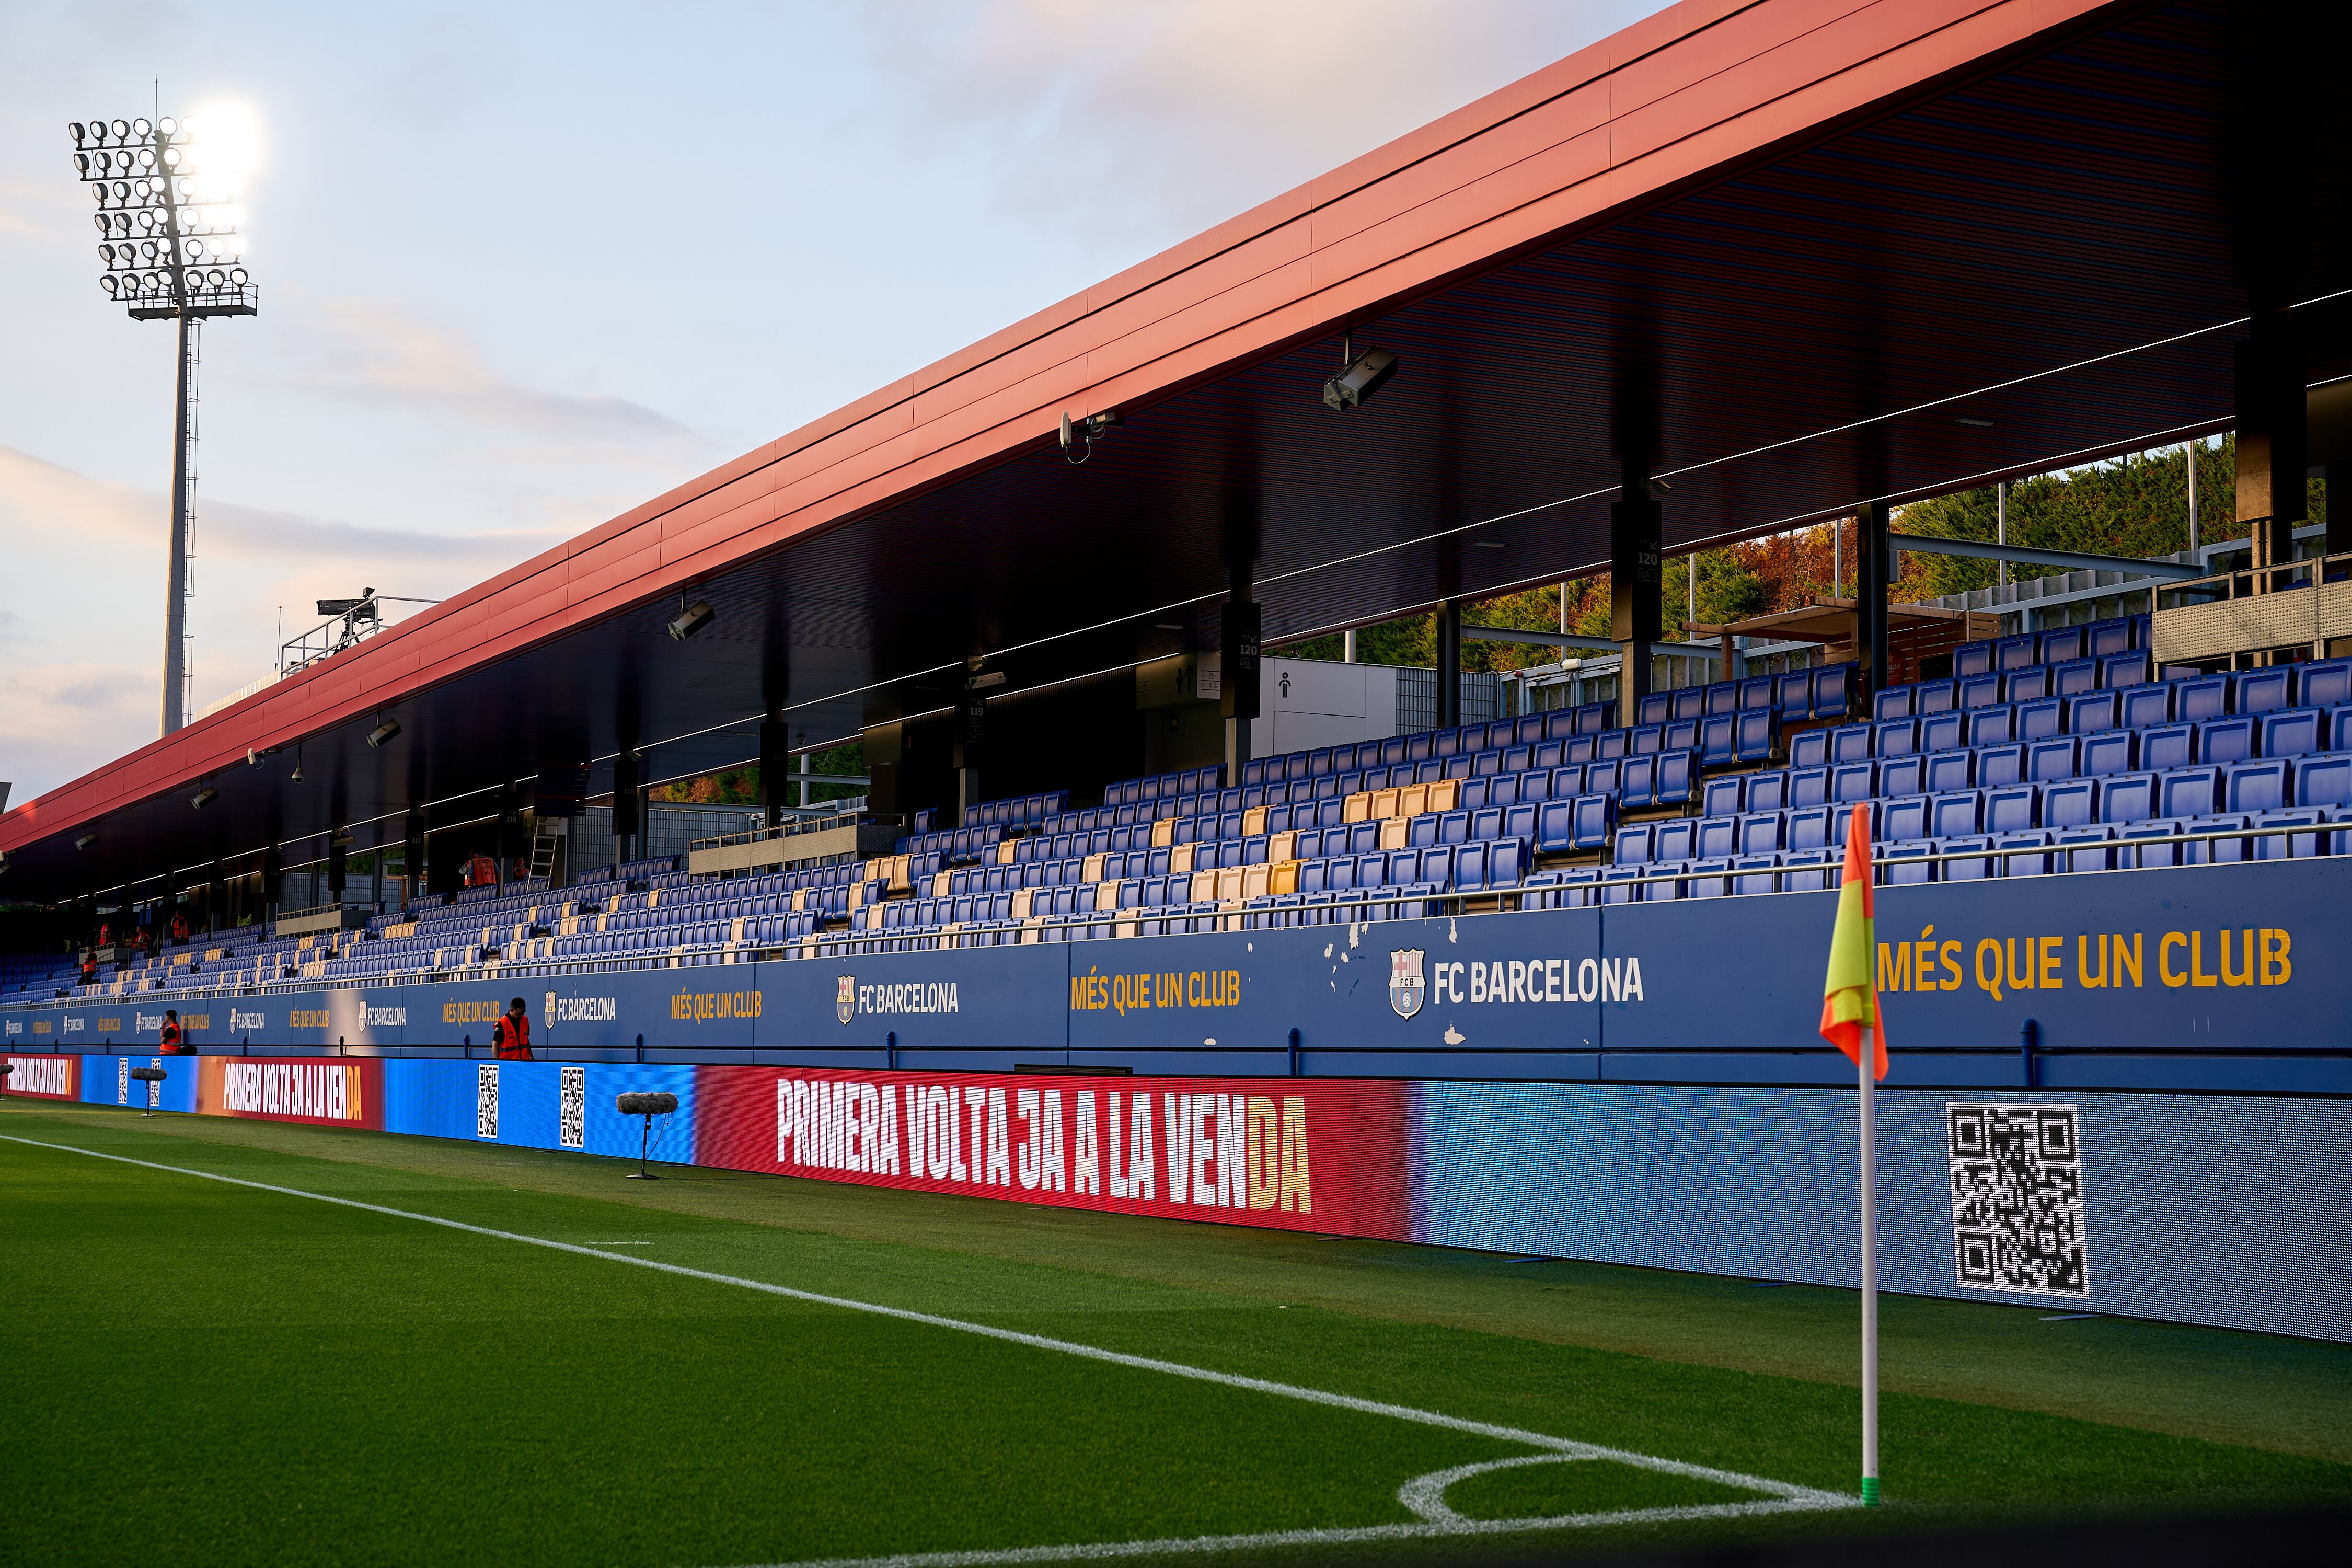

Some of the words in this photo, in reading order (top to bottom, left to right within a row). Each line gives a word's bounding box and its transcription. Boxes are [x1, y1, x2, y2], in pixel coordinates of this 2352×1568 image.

[1638, 552, 1658, 566] 120
[1240, 644, 1258, 655] 120
[970, 707, 984, 716] 119
[1878, 924, 1963, 992] MÉS
[1976, 936, 2063, 1001] QUE
[2078, 933, 2143, 988] UN
[2159, 928, 2292, 987] CLUB
[1071, 965, 1108, 1009] MÉS
[1113, 974, 1150, 1016] QUE
[1156, 972, 1182, 1007] UN
[1189, 970, 1240, 1007] CLUB
[1400, 978, 1414, 987] FCB
[1434, 962, 1465, 1004] FC
[1471, 957, 1644, 1003] BARCELONA
[558, 998, 567, 1021] FC
[568, 997, 616, 1021] BARCELONA
[672, 986, 693, 1019] MÉS
[694, 992, 715, 1024] QUE
[717, 991, 732, 1018] UN
[734, 990, 762, 1018] CLUB
[859, 985, 874, 1013] FC
[877, 982, 958, 1013] BARCELONA
[141, 1017, 145, 1030] FC
[194, 1014, 200, 1029] UN
[200, 1014, 209, 1029] CLUB
[236, 1013, 241, 1029] FC
[241, 1012, 264, 1029] BARCELONA
[290, 1006, 299, 1027] MÉS
[300, 1010, 309, 1031] QUE
[309, 1010, 316, 1027] UN
[317, 1010, 329, 1027] CLUB
[367, 1007, 374, 1025] FC
[374, 1007, 406, 1026] BARCELONA
[443, 997, 456, 1022] MÉS
[457, 1002, 470, 1027] QUE
[471, 1001, 481, 1022] UN
[482, 1001, 499, 1022] CLUB
[26, 1058, 41, 1092] VOLTA
[40, 1058, 47, 1093] JA
[46, 1059, 51, 1093] A
[50, 1059, 56, 1094] LA
[56, 1059, 72, 1096] VENDA
[223, 1063, 262, 1112] PRIMERA
[263, 1064, 290, 1114] VOLTA
[291, 1065, 304, 1115] JA
[305, 1065, 312, 1116] A
[314, 1065, 325, 1117] LA
[326, 1065, 362, 1121] VENDA
[777, 1079, 899, 1175] PRIMERA
[906, 1085, 1010, 1186] VOLTA
[1018, 1089, 1065, 1192] JA
[1074, 1091, 1099, 1195] A
[1109, 1091, 1155, 1201] LA
[1164, 1093, 1312, 1214] VENDA
